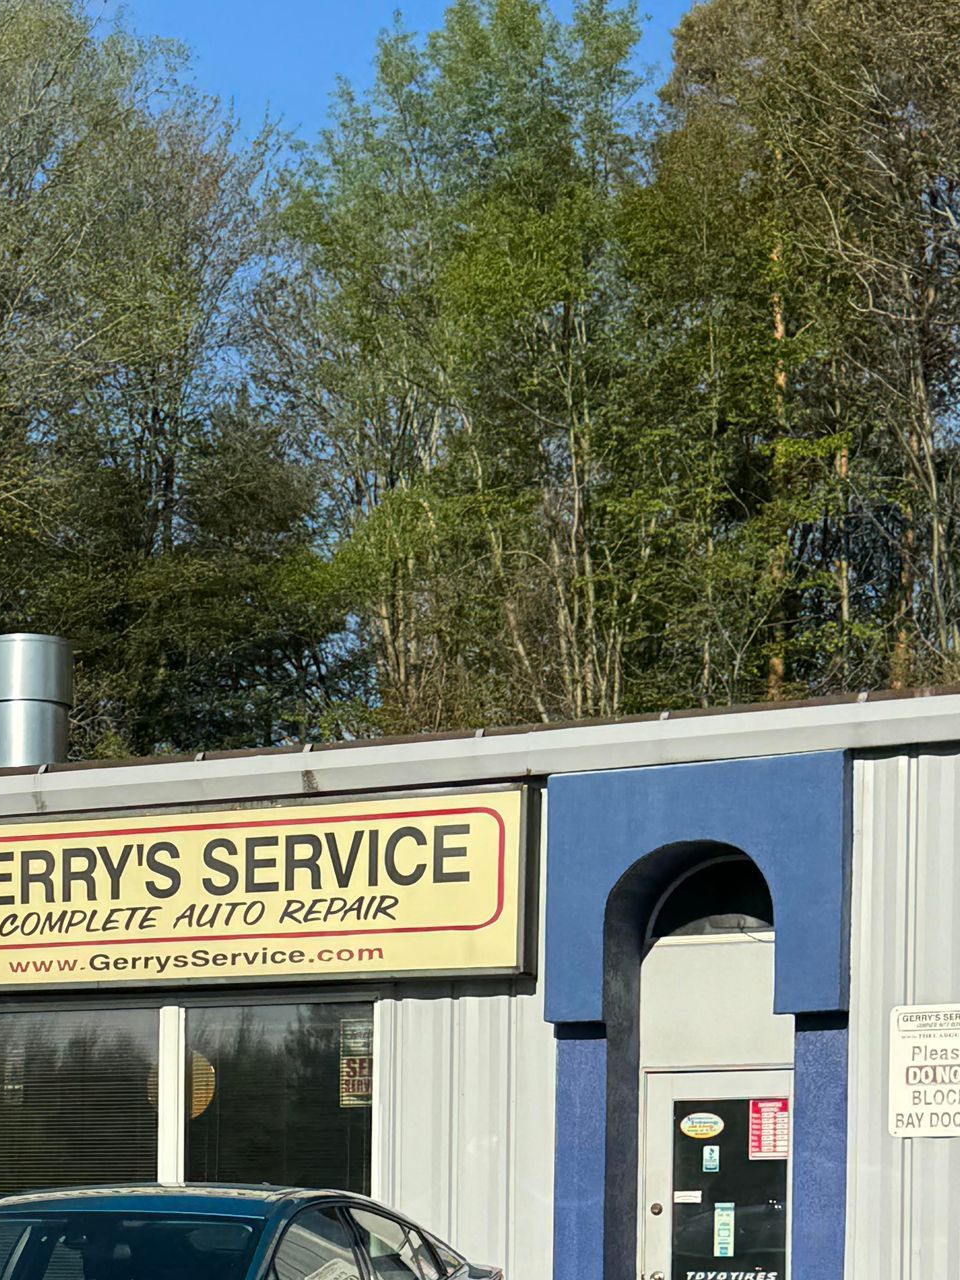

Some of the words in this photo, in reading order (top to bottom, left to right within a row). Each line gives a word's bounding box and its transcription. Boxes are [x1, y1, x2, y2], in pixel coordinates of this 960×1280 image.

[202, 824, 470, 896] SERVICE
[0, 905, 162, 937] COMPLETE
[173, 901, 266, 928] AUTO
[279, 895, 400, 924] REPAIR
[9, 947, 384, 974] www.GerrysService.com
[908, 1065, 934, 1084] DO
[912, 1089, 960, 1105] BLOC
[895, 1112, 924, 1128] BAY
[686, 1272, 728, 1280] TOYO
